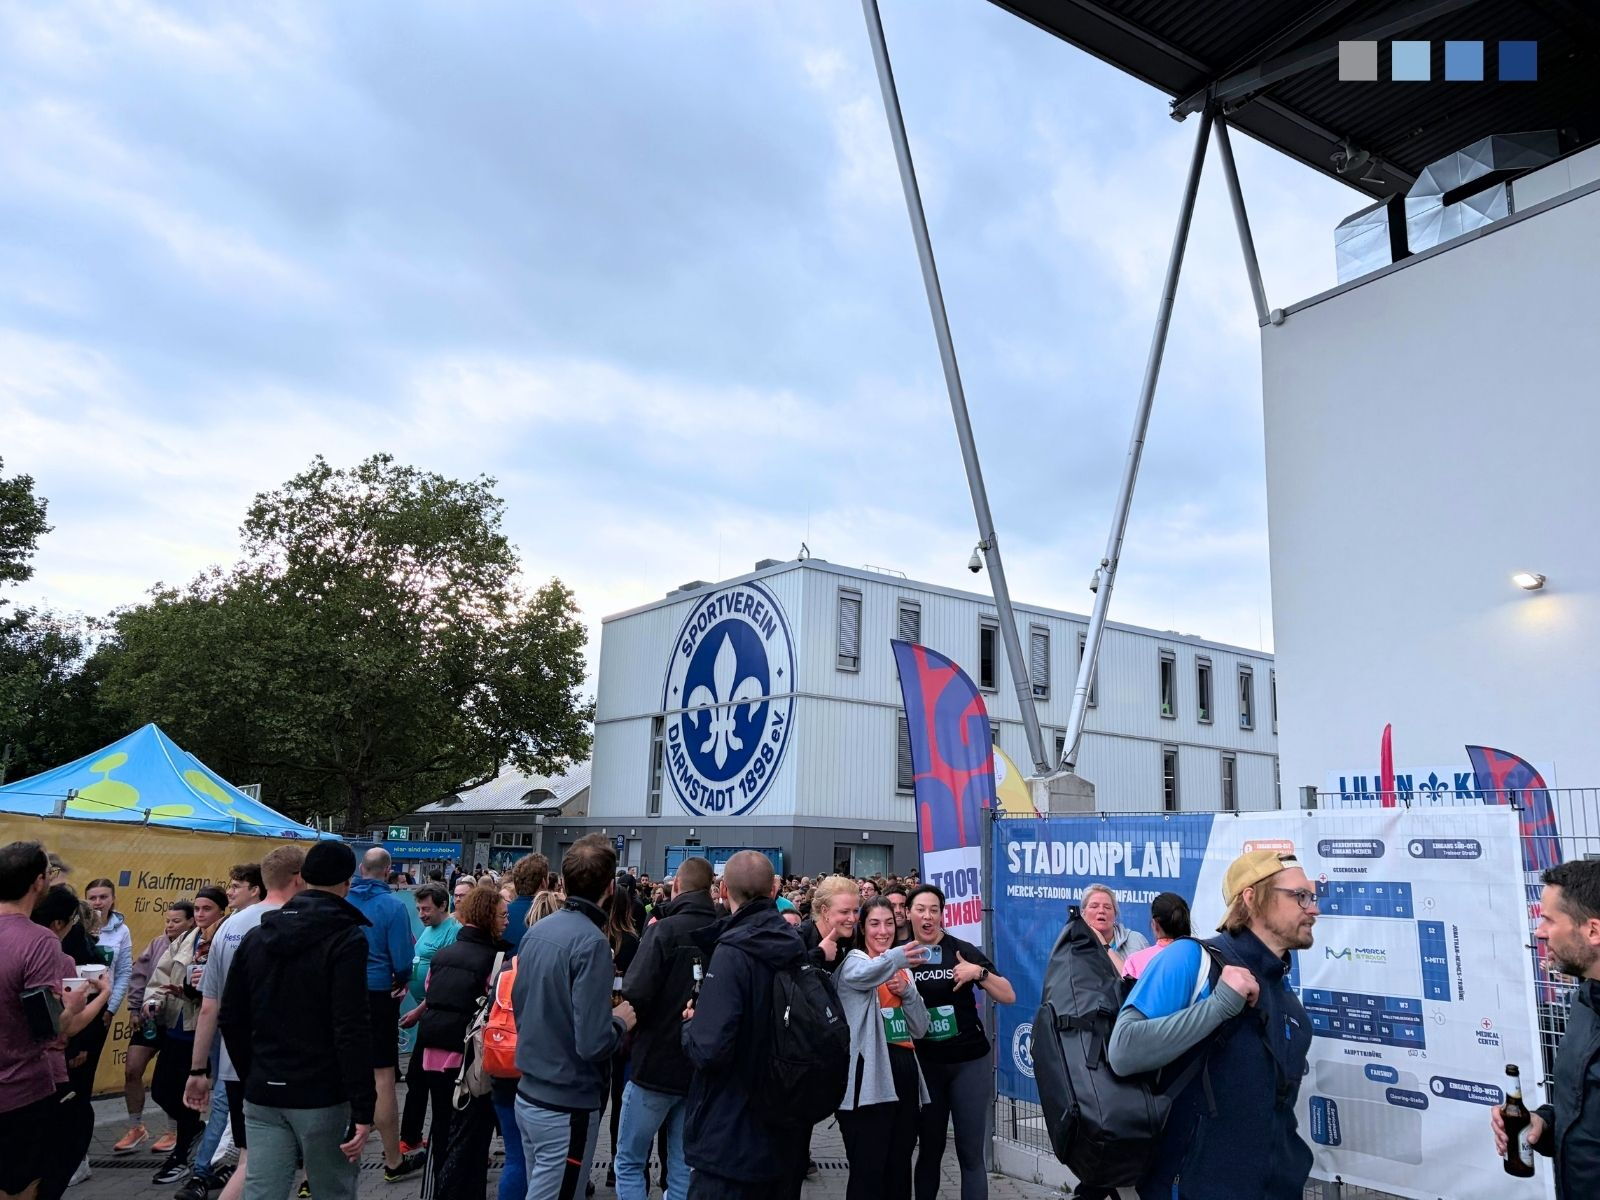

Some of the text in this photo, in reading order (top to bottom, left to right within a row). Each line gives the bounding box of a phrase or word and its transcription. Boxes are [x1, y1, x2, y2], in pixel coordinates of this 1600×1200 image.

[681, 591, 777, 658] SPORTVEREIN
[668, 710, 786, 812] DARMSTADT 1898 e.V.
[1339, 774, 1415, 801] LILIN
[1007, 841, 1181, 878] STADIONPLAN
[138, 871, 210, 891] Kaufmann
[1007, 885, 1071, 900] MERCK-STADION
[1111, 889, 1161, 904] NFALLTO
[134, 897, 150, 912] für
[113, 1022, 131, 1041] Ba
[890, 1020, 906, 1033] 107
[928, 1018, 950, 1033] 086
[1476, 1030, 1500, 1039] MEDICAL
[1478, 1038, 1499, 1047] CENTER
[112, 1050, 128, 1065] Tra
[1344, 1048, 1382, 1058] HAUPTTRIBÜNE
[1370, 1069, 1392, 1078] FANSHOP
[1450, 1082, 1499, 1096] EINGANG SÜD-WEST
